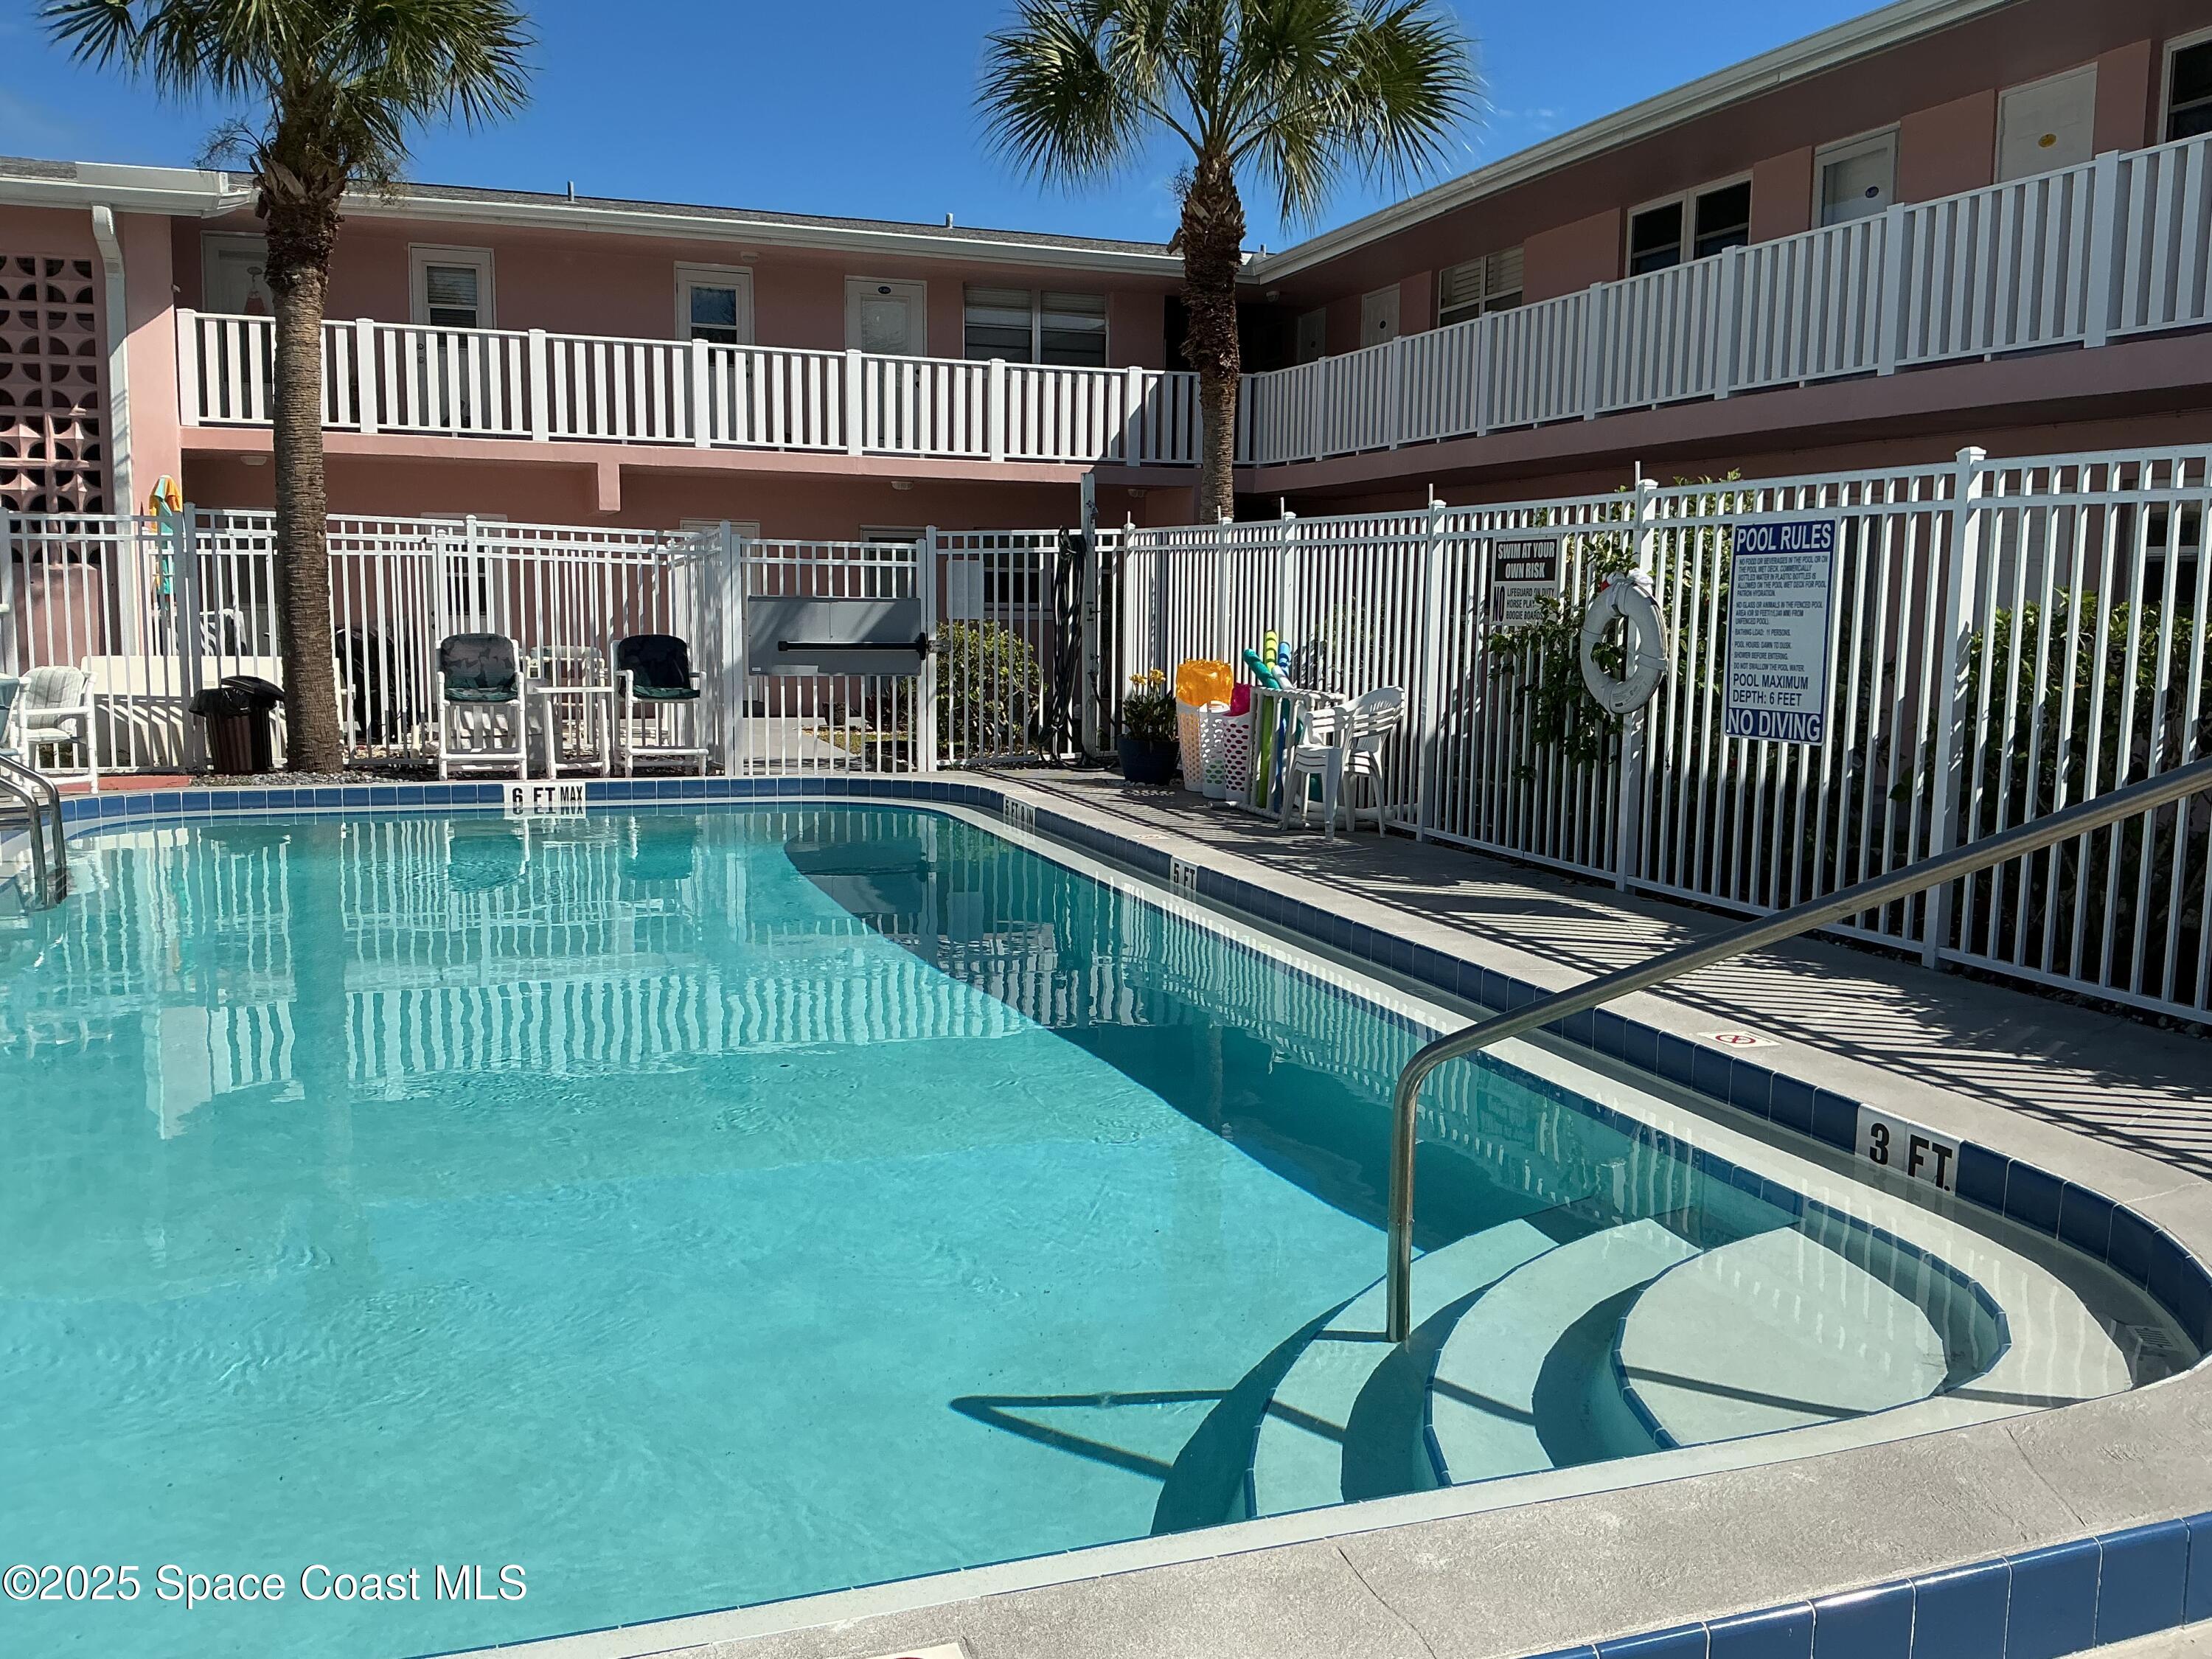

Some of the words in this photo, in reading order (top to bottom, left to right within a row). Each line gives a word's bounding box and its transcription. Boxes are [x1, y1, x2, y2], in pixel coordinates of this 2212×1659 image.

[1736, 526, 1776, 552] POOL
[1780, 524, 1832, 550] RULES
[1498, 543, 1521, 560] SWIM
[1522, 543, 1532, 558] AT
[1533, 542, 1555, 558] YOUR
[1505, 563, 1524, 579] OWN
[1525, 562, 1545, 578] RISK
[1507, 588, 1533, 597] LIFEGUARD
[1542, 588, 1555, 597] DUTY
[1492, 585, 1506, 622] NO
[1506, 599, 1523, 608] HORSE
[1523, 599, 1535, 608] PLAY
[1506, 611, 1523, 619] BOOGIE
[1523, 611, 1543, 619] BOARDS
[1733, 673, 1759, 687] POOL
[1762, 675, 1808, 690] MAXIMUM
[1733, 690, 1767, 704] DEPTH:
[1770, 692, 1775, 705] 6
[1777, 692, 1802, 706] FEET
[1728, 709, 1753, 735] NO
[1759, 711, 1820, 741] DIVING
[512, 787, 523, 803] 6
[533, 787, 556, 803] FT
[560, 786, 582, 802] MAX
[1005, 799, 1009, 815] 5
[1012, 801, 1019, 820] FT
[1020, 805, 1025, 822] 8
[1026, 808, 1034, 826] IN
[1174, 863, 1180, 883] 5
[1183, 866, 1196, 891] FT
[1869, 1122, 1890, 1165] 3
[1907, 1134, 1952, 1192] FT.
